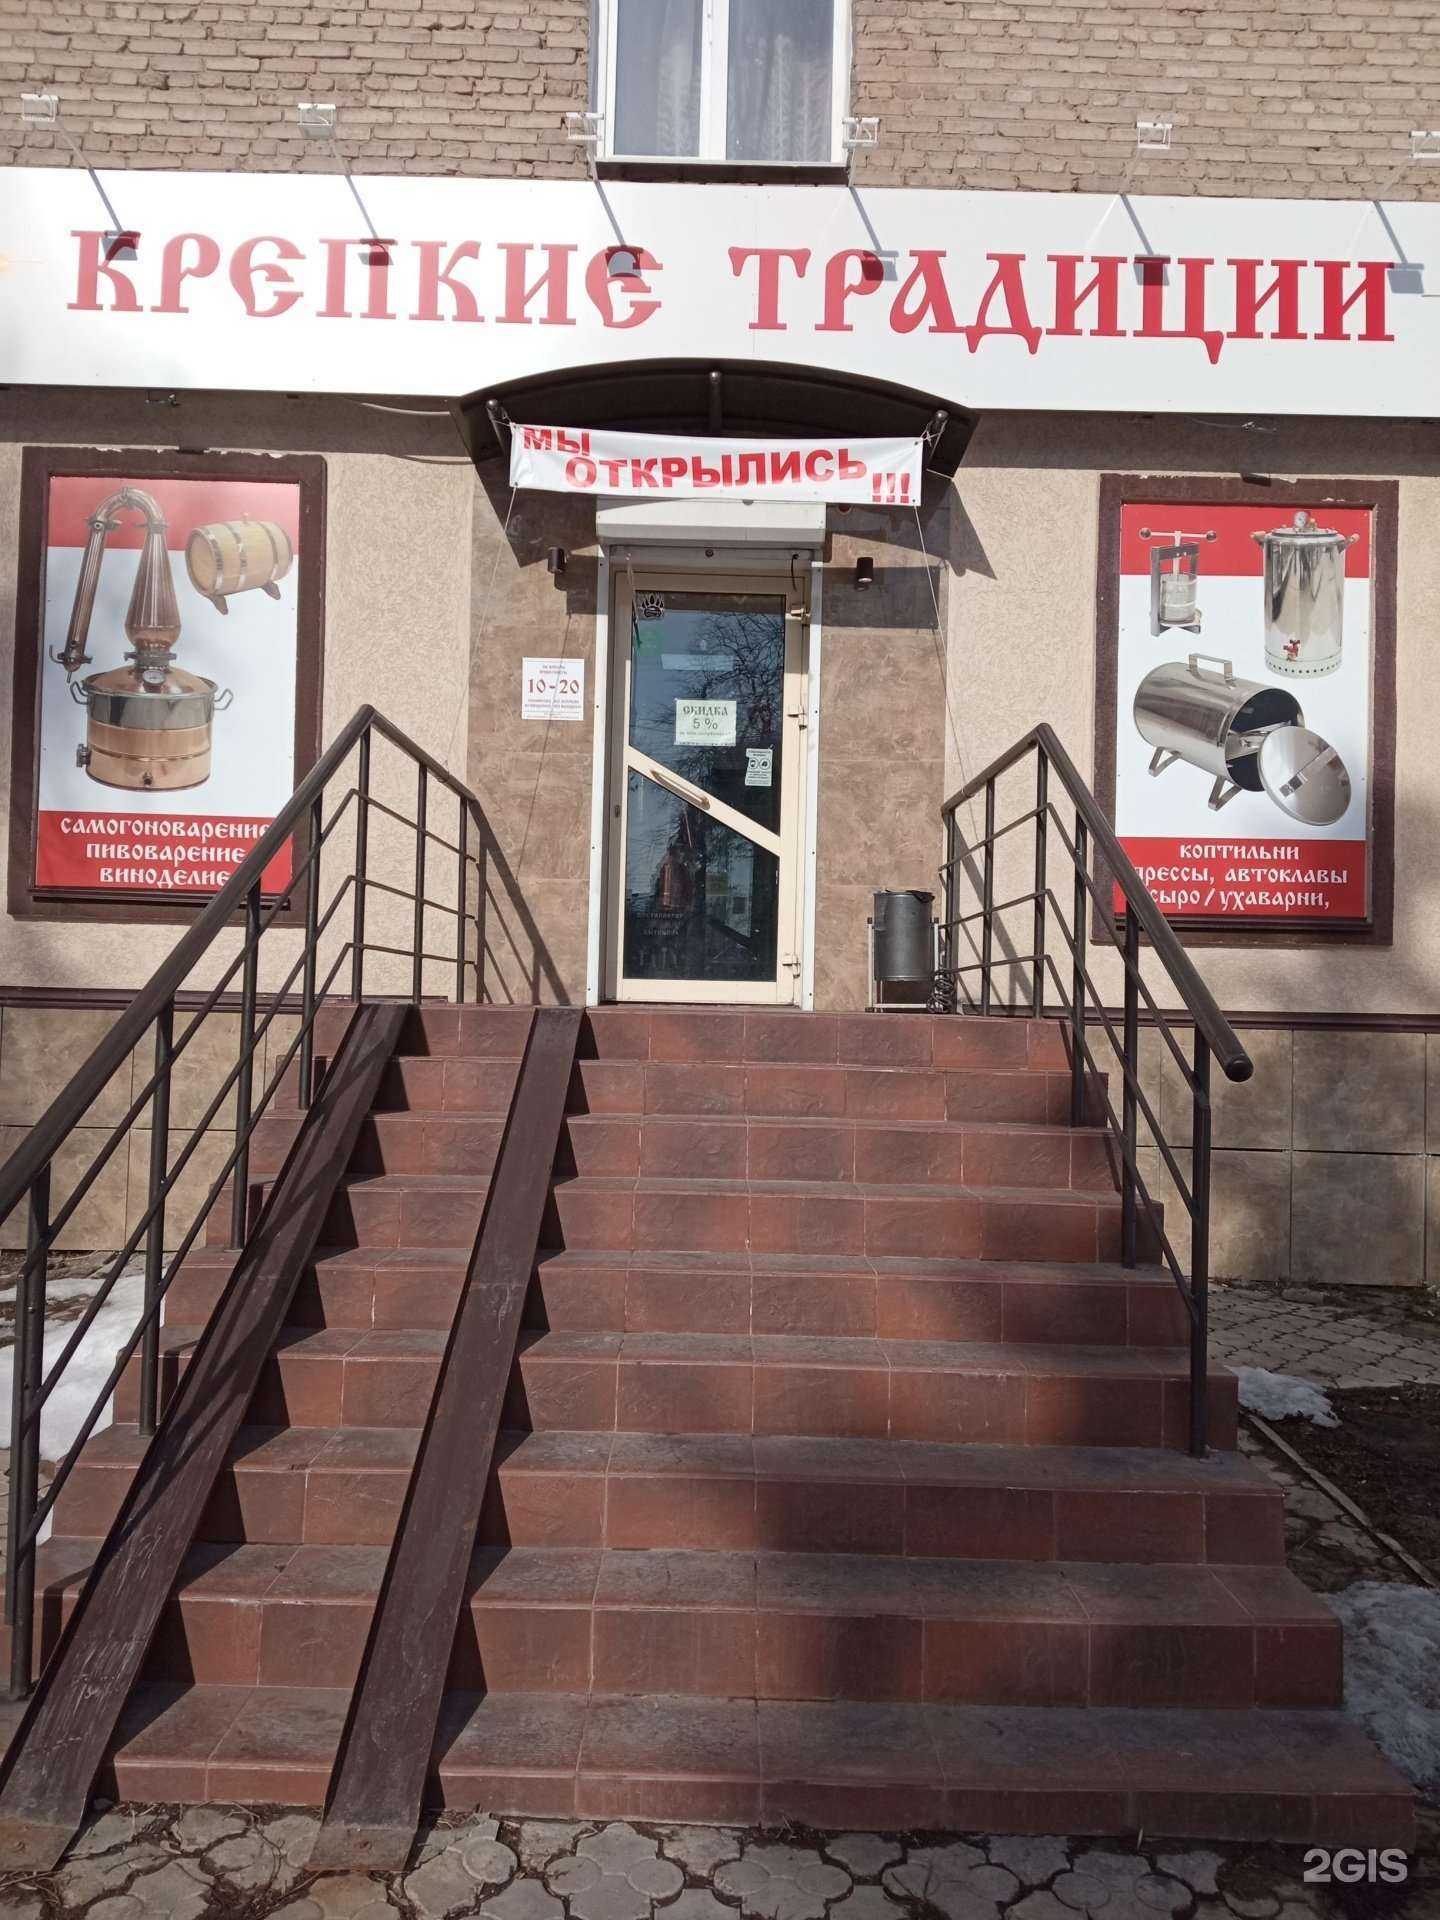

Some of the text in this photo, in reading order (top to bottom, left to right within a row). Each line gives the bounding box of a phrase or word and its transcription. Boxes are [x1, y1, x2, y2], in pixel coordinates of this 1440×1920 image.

[66, 230, 1395, 365] КРЕПКИЕ ТРАДИЦИИ
[523, 427, 591, 457] МЫ
[564, 447, 911, 504] ОТКРЫЛИСЬ !!!
